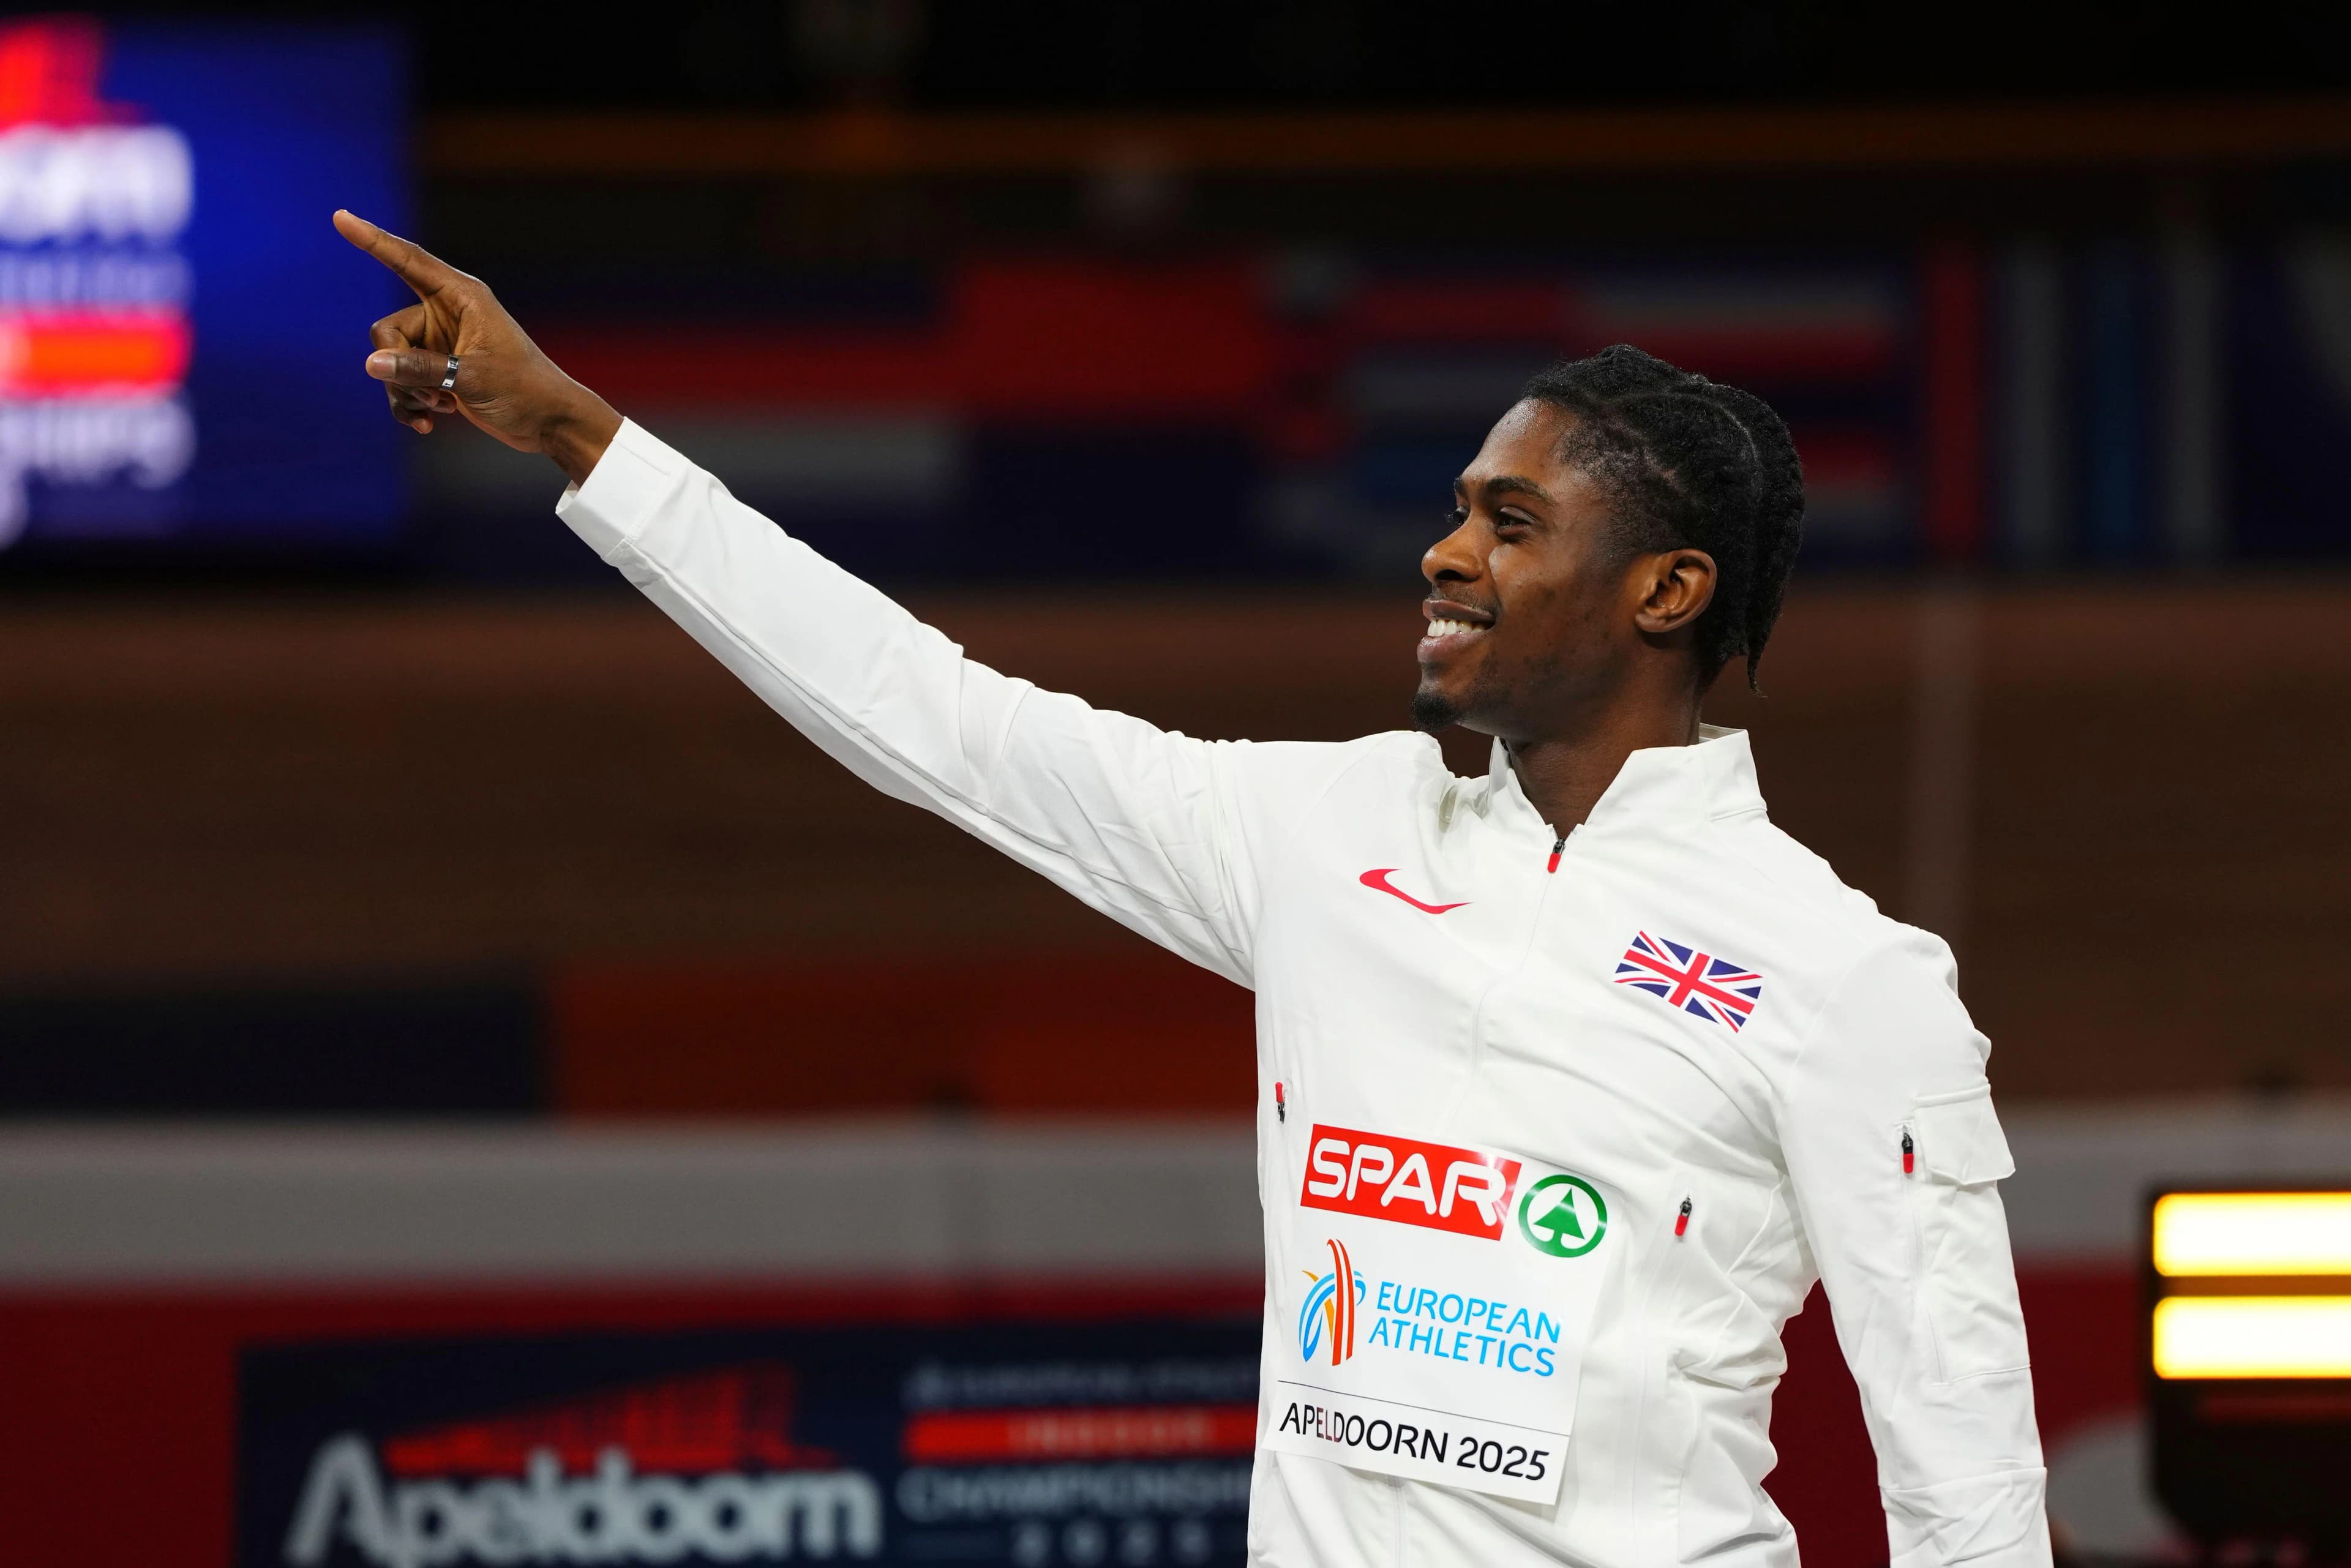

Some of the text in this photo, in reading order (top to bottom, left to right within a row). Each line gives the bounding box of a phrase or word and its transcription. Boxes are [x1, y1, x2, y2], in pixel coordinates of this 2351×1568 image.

[1308, 1137, 1507, 1226] SPAR
[1368, 1316, 1556, 1378] ATHLETICS
[1376, 1280, 1561, 1344] EUROPEAN
[1278, 1402, 1550, 1481] APELDOORN 2025
